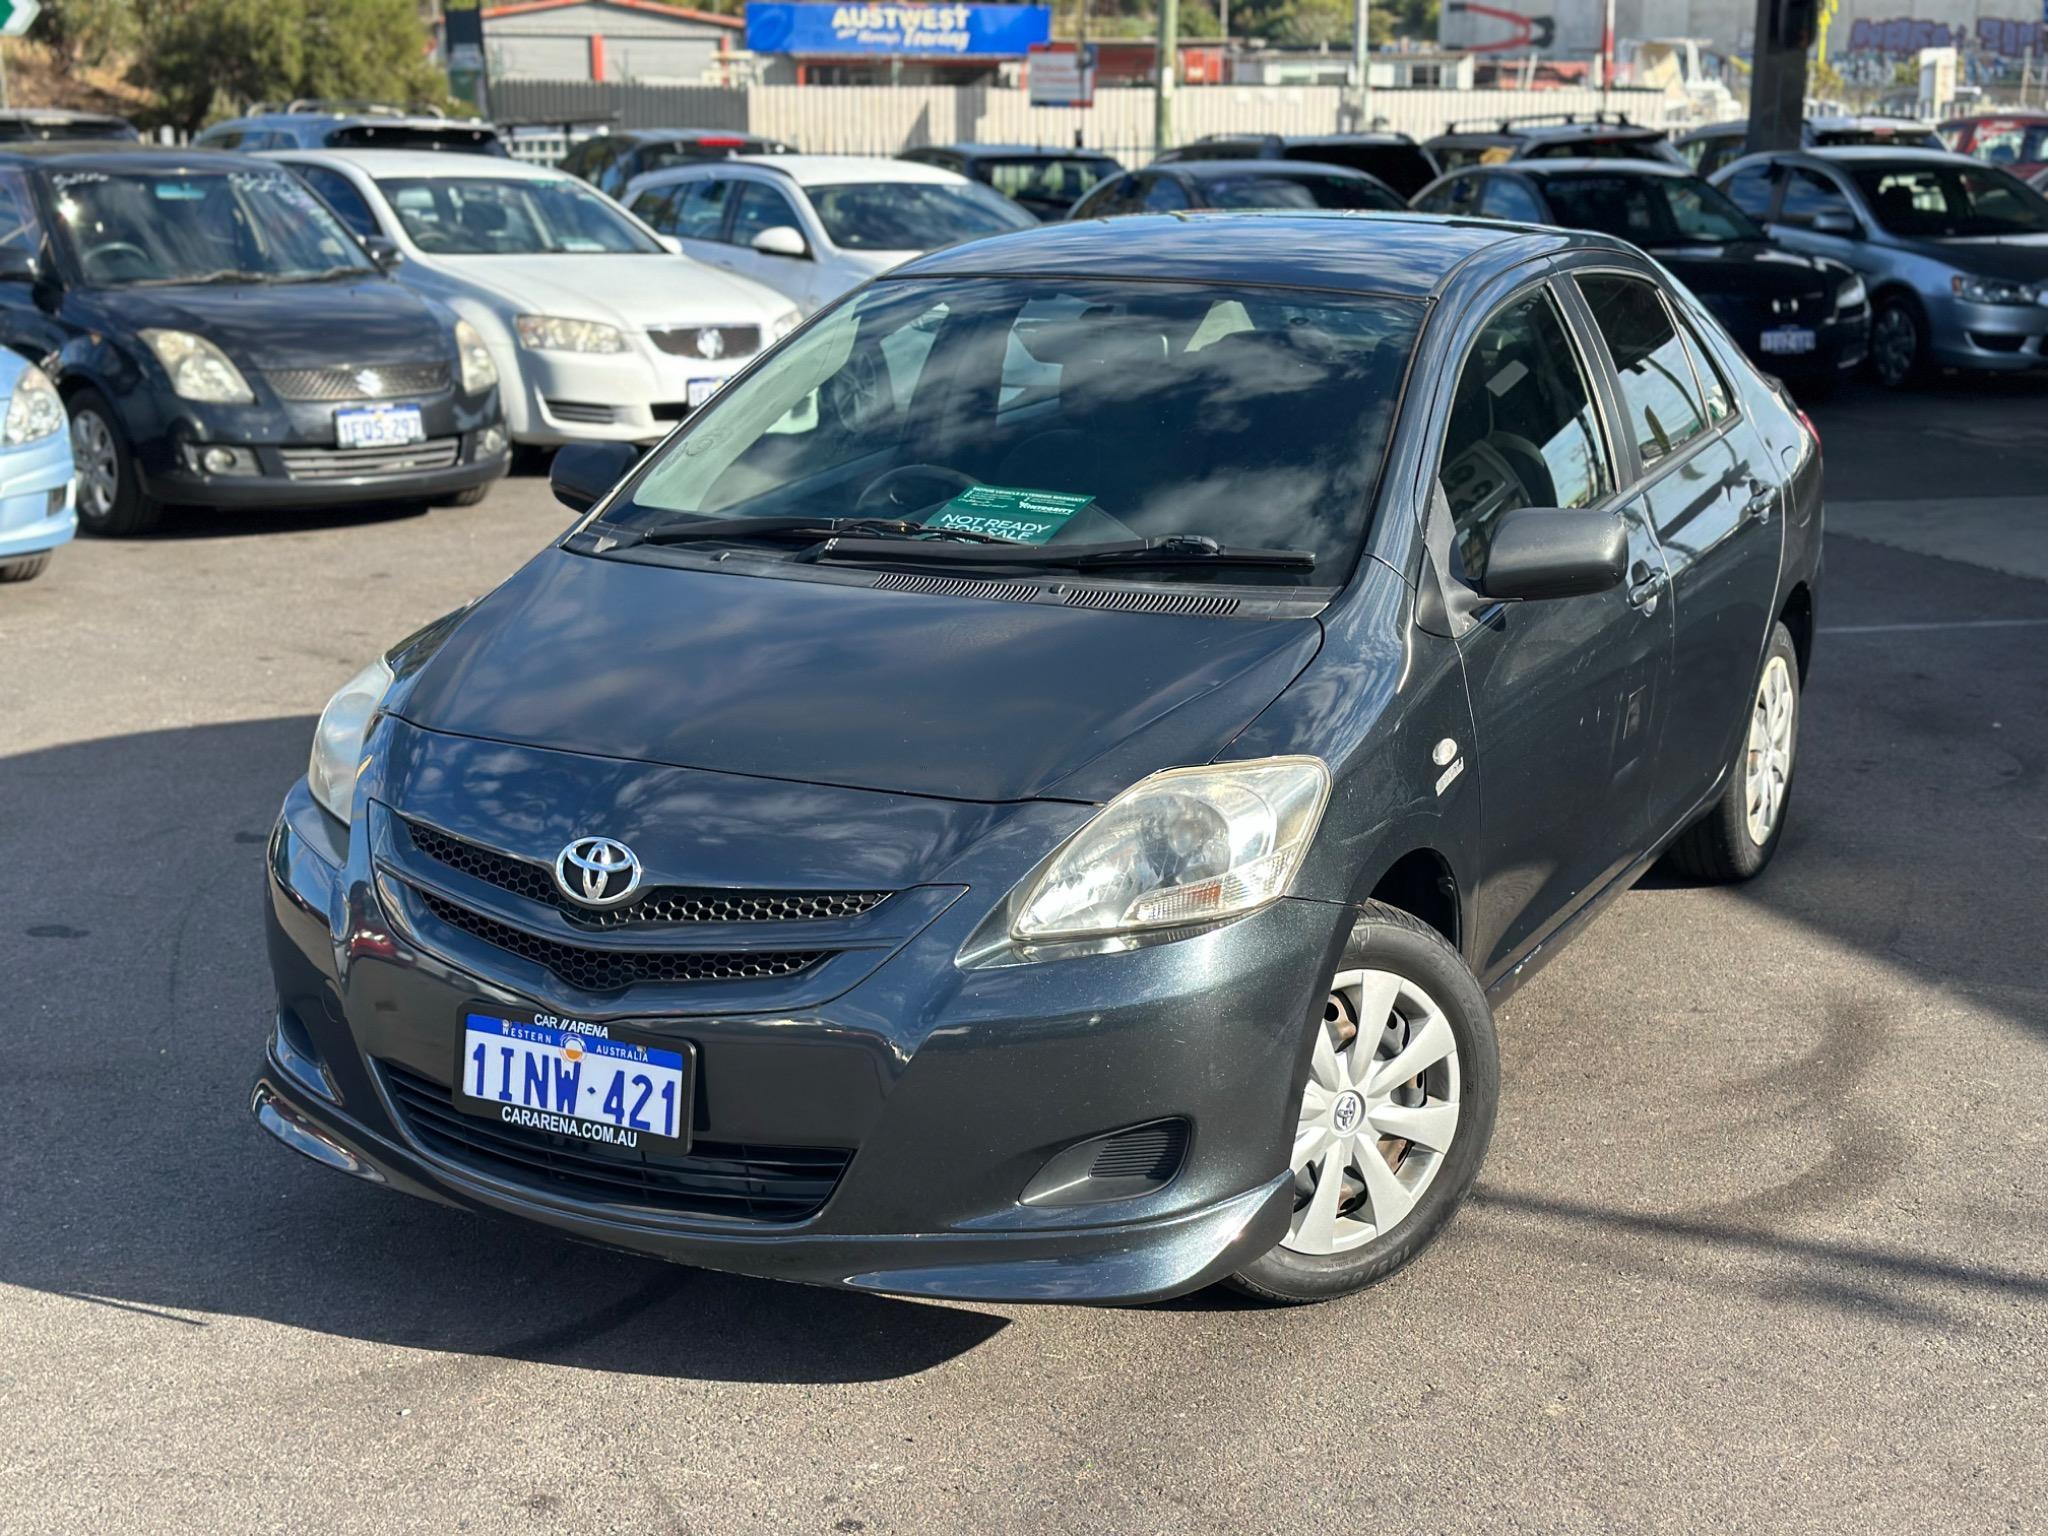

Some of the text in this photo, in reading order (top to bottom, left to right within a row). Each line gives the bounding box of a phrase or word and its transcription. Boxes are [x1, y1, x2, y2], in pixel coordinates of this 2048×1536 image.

[941, 514, 1052, 534] NOT READY
[987, 527, 1032, 541] SALE
[502, 1025, 648, 1063] WESTERN AUSTRALIA
[501, 1106, 638, 1148] CARARENA.COM.AU
